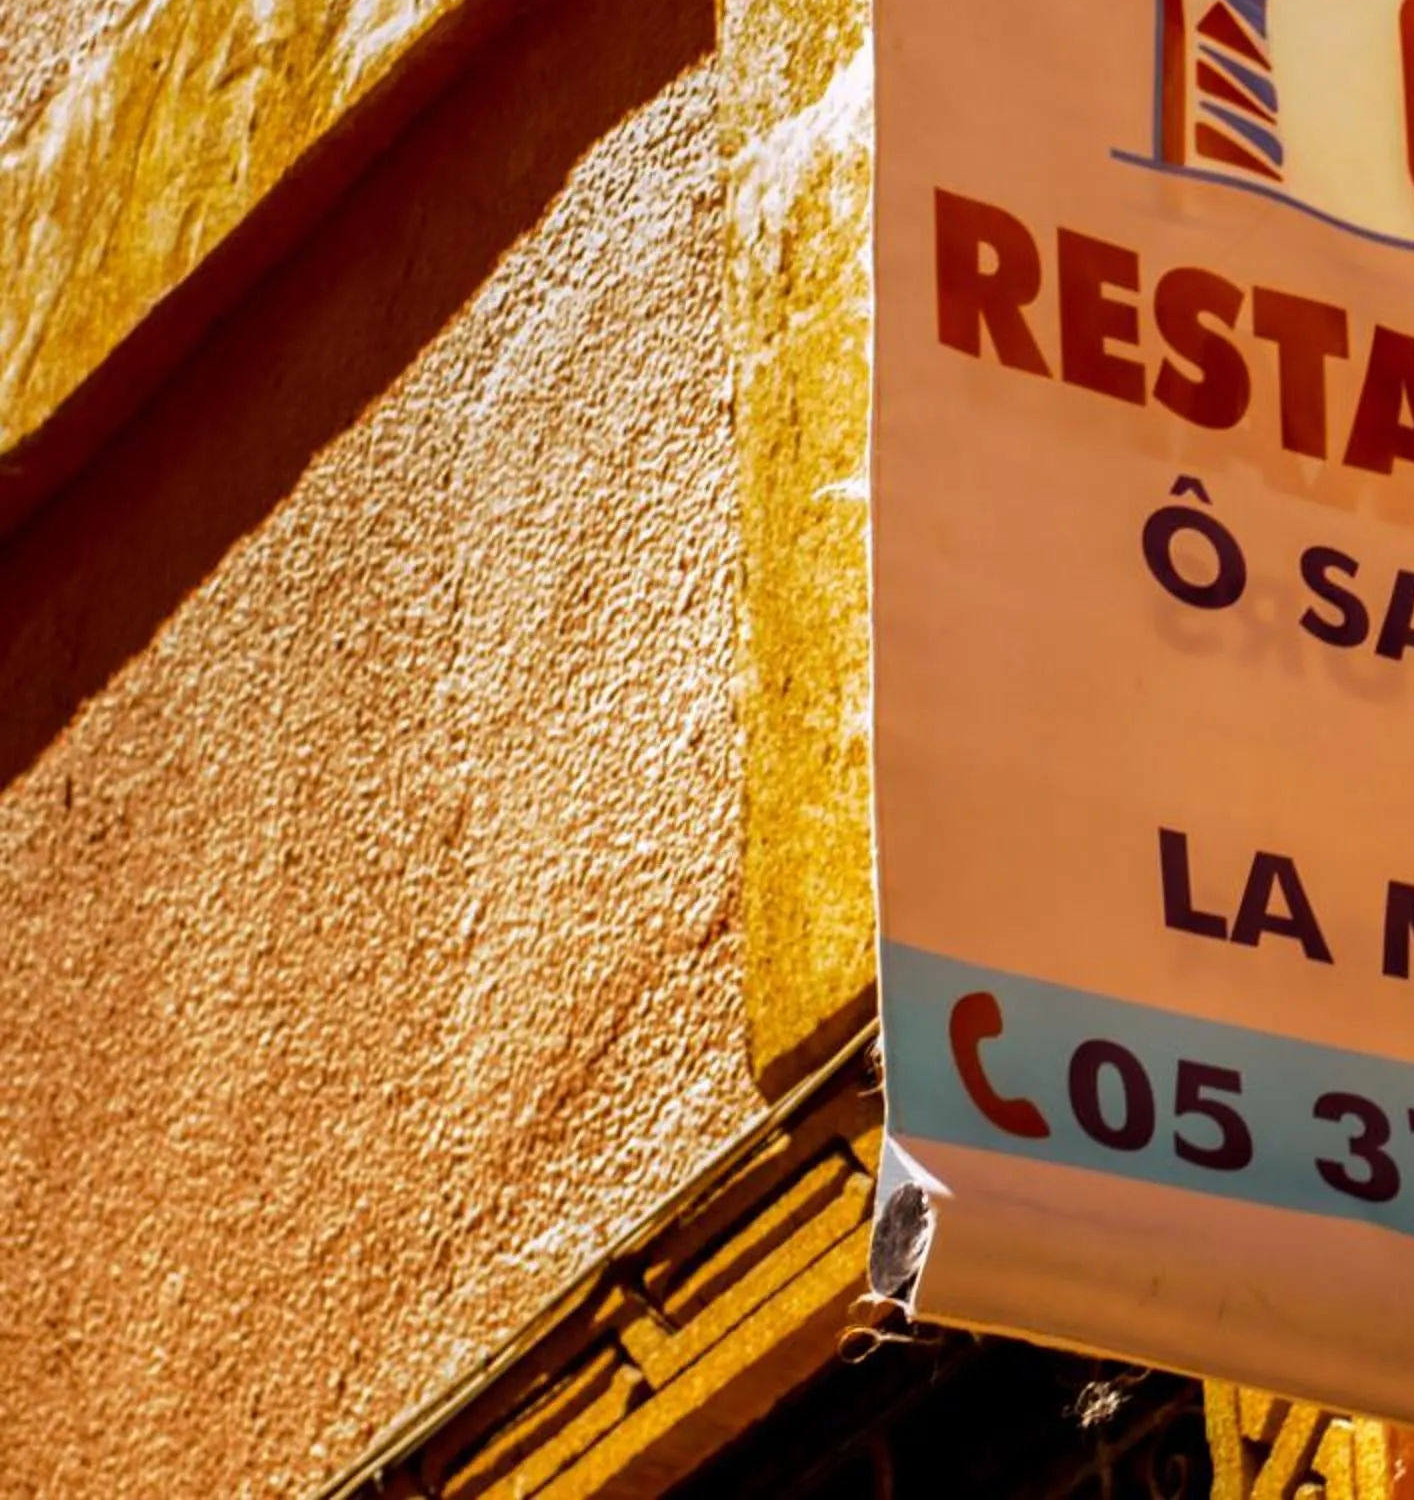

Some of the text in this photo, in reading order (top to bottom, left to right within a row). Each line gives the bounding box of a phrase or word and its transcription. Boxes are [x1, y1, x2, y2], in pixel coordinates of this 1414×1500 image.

[1141, 475, 1248, 610] Ô
[1158, 827, 1334, 964] LA
[1066, 1037, 1254, 1173] 05
